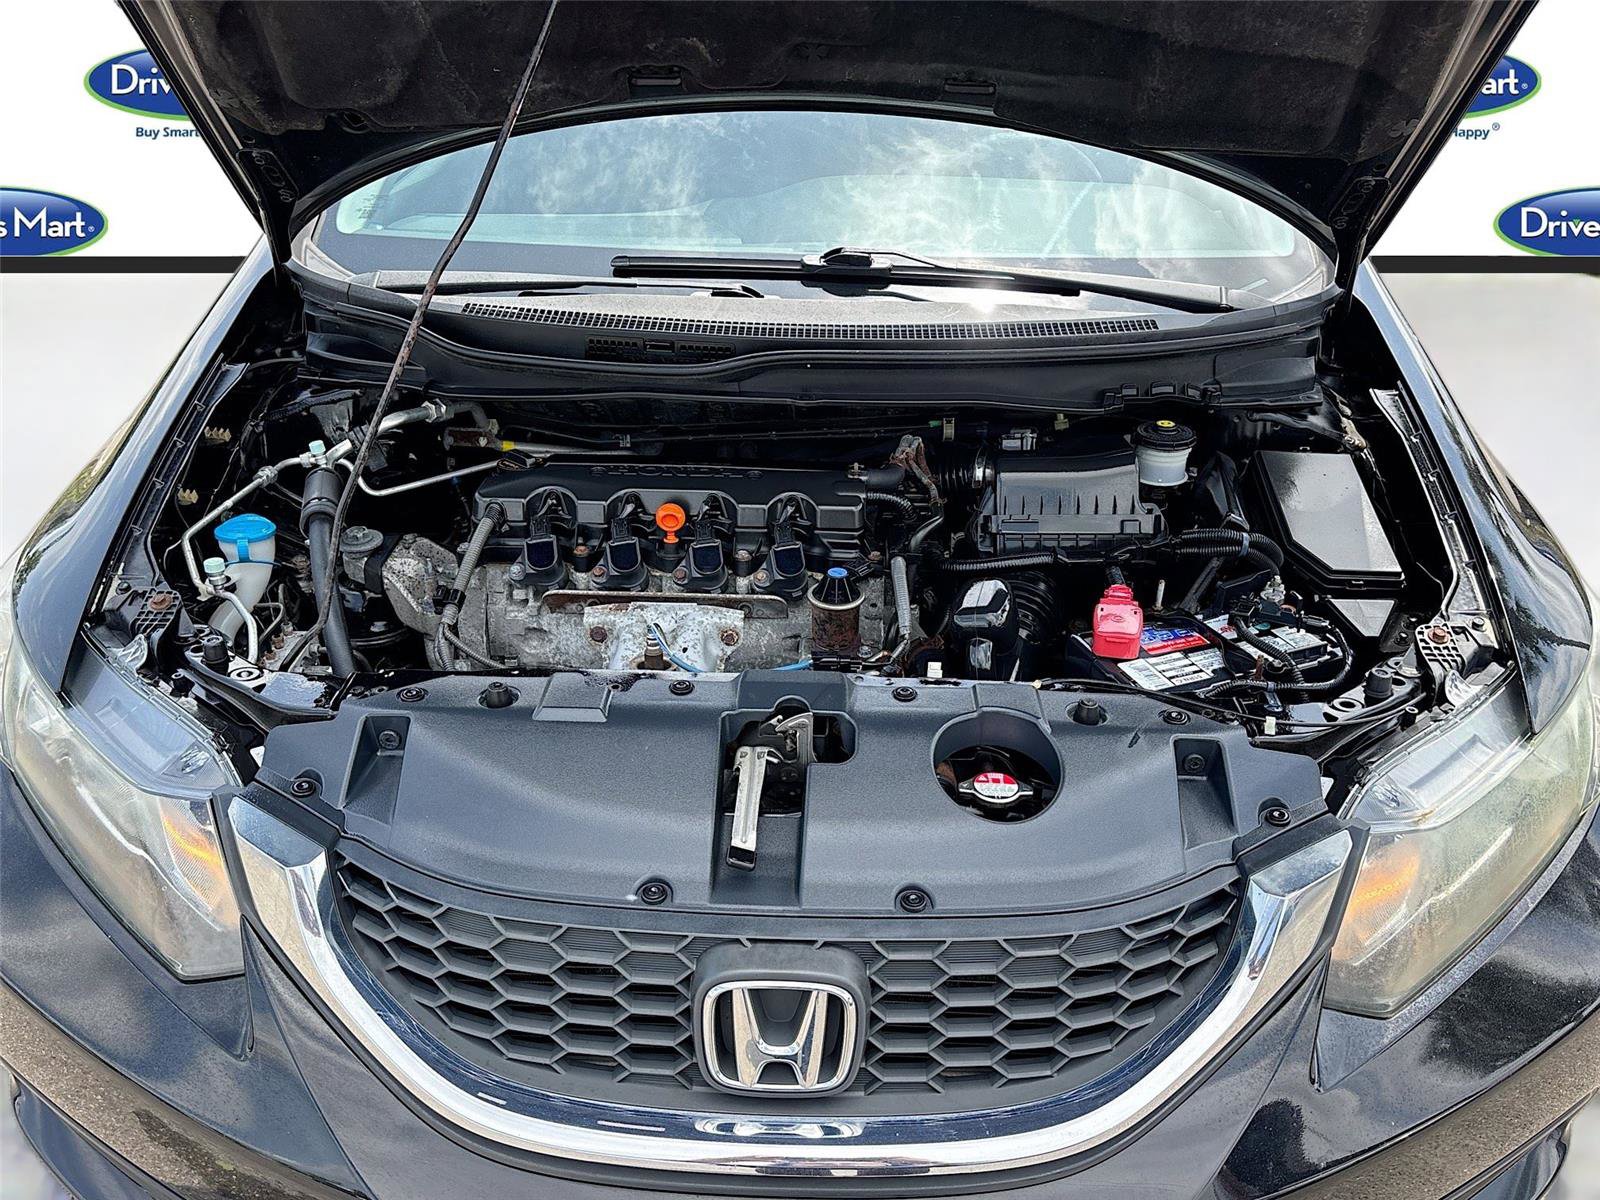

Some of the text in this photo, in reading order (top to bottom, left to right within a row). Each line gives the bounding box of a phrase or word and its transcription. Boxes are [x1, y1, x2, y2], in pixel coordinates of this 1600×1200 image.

[135, 126, 200, 140] Buy Smart
[13, 206, 86, 238] Mart
